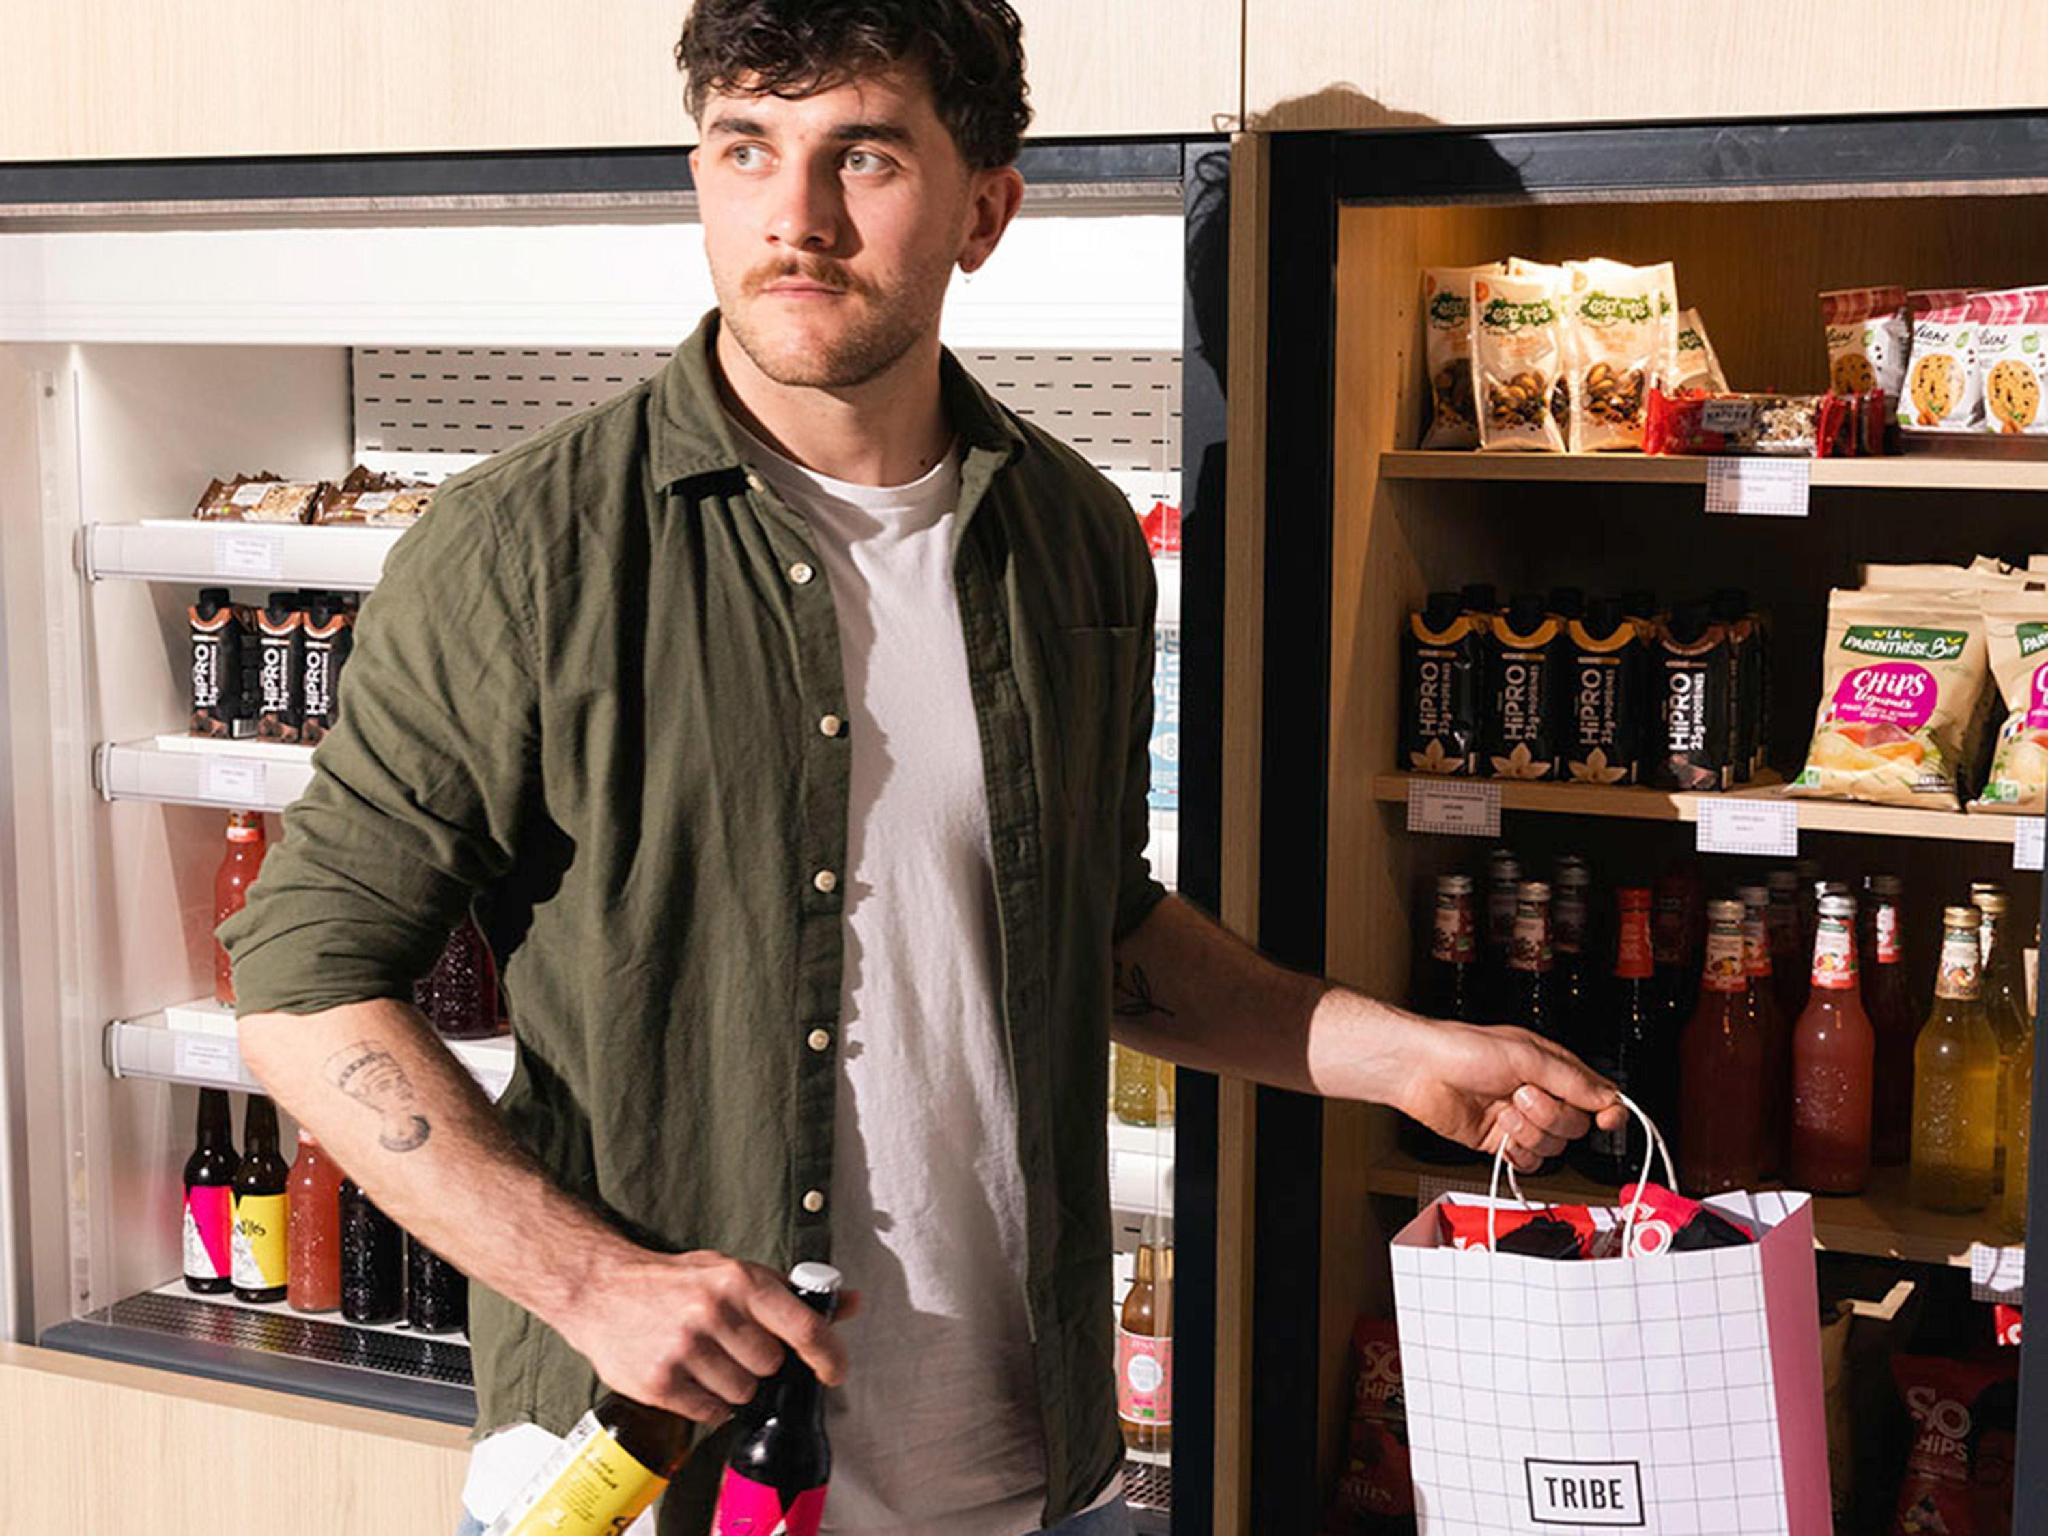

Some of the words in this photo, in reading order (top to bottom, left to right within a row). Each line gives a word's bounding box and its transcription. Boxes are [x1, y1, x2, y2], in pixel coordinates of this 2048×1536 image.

[1886, 630, 1901, 639] LA
[1419, 661, 1439, 736] HiPRO
[1504, 664, 1526, 740] HiPRO
[1579, 668, 1601, 744] HiPRO
[1668, 672, 1691, 751] HiPRO
[1544, 1476, 1624, 1510] TRIBE
